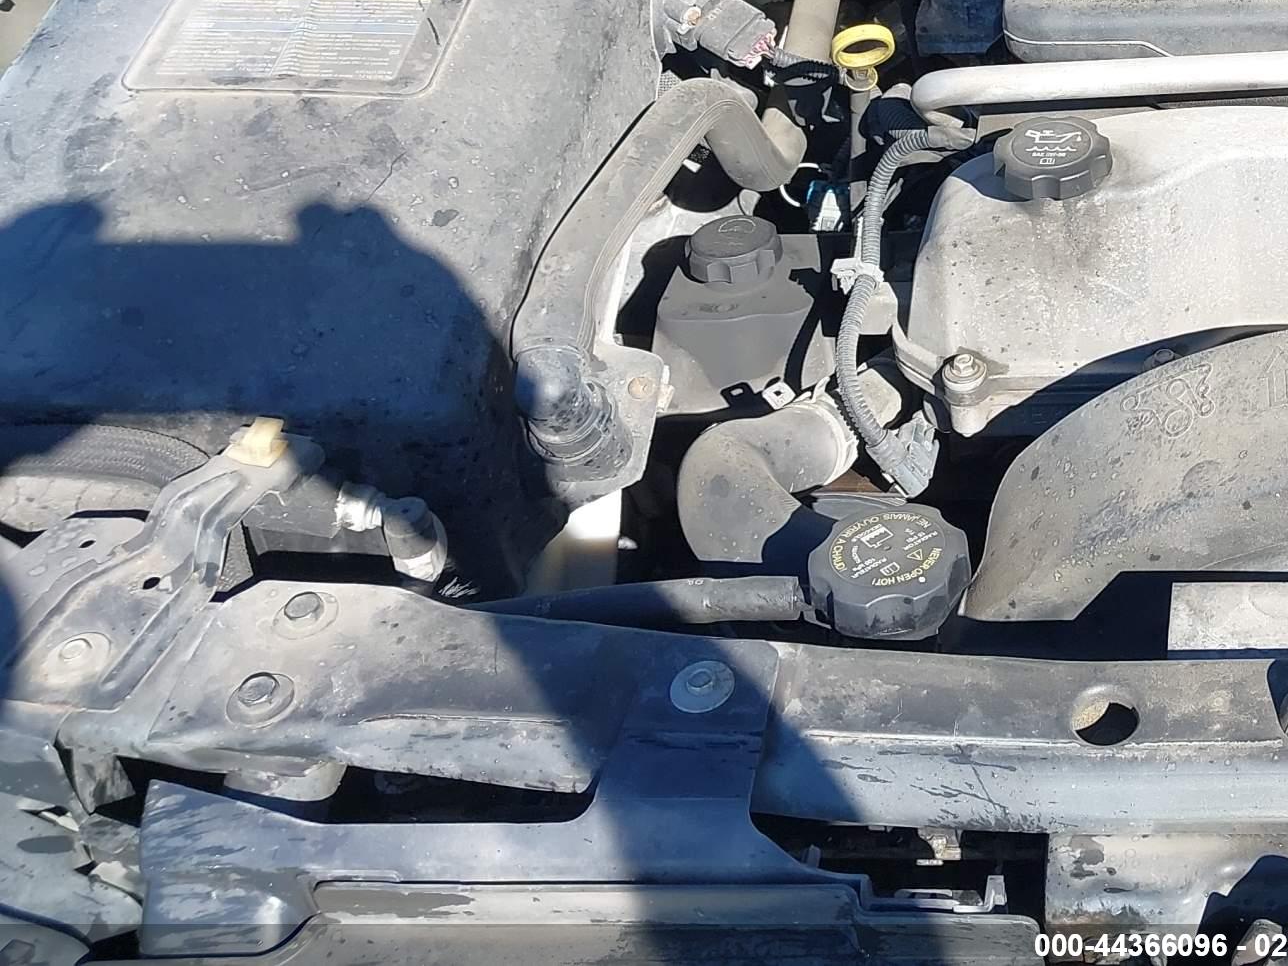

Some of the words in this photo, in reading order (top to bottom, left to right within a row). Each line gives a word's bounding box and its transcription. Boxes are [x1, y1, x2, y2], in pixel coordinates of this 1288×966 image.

[882, 512, 920, 522] JAMAIS
[916, 517, 931, 529] NE
[842, 516, 880, 538] OUVRIR
[920, 547, 943, 571] NEVER
[896, 568, 923, 581] OPEN
[871, 576, 896, 586] HOT!
